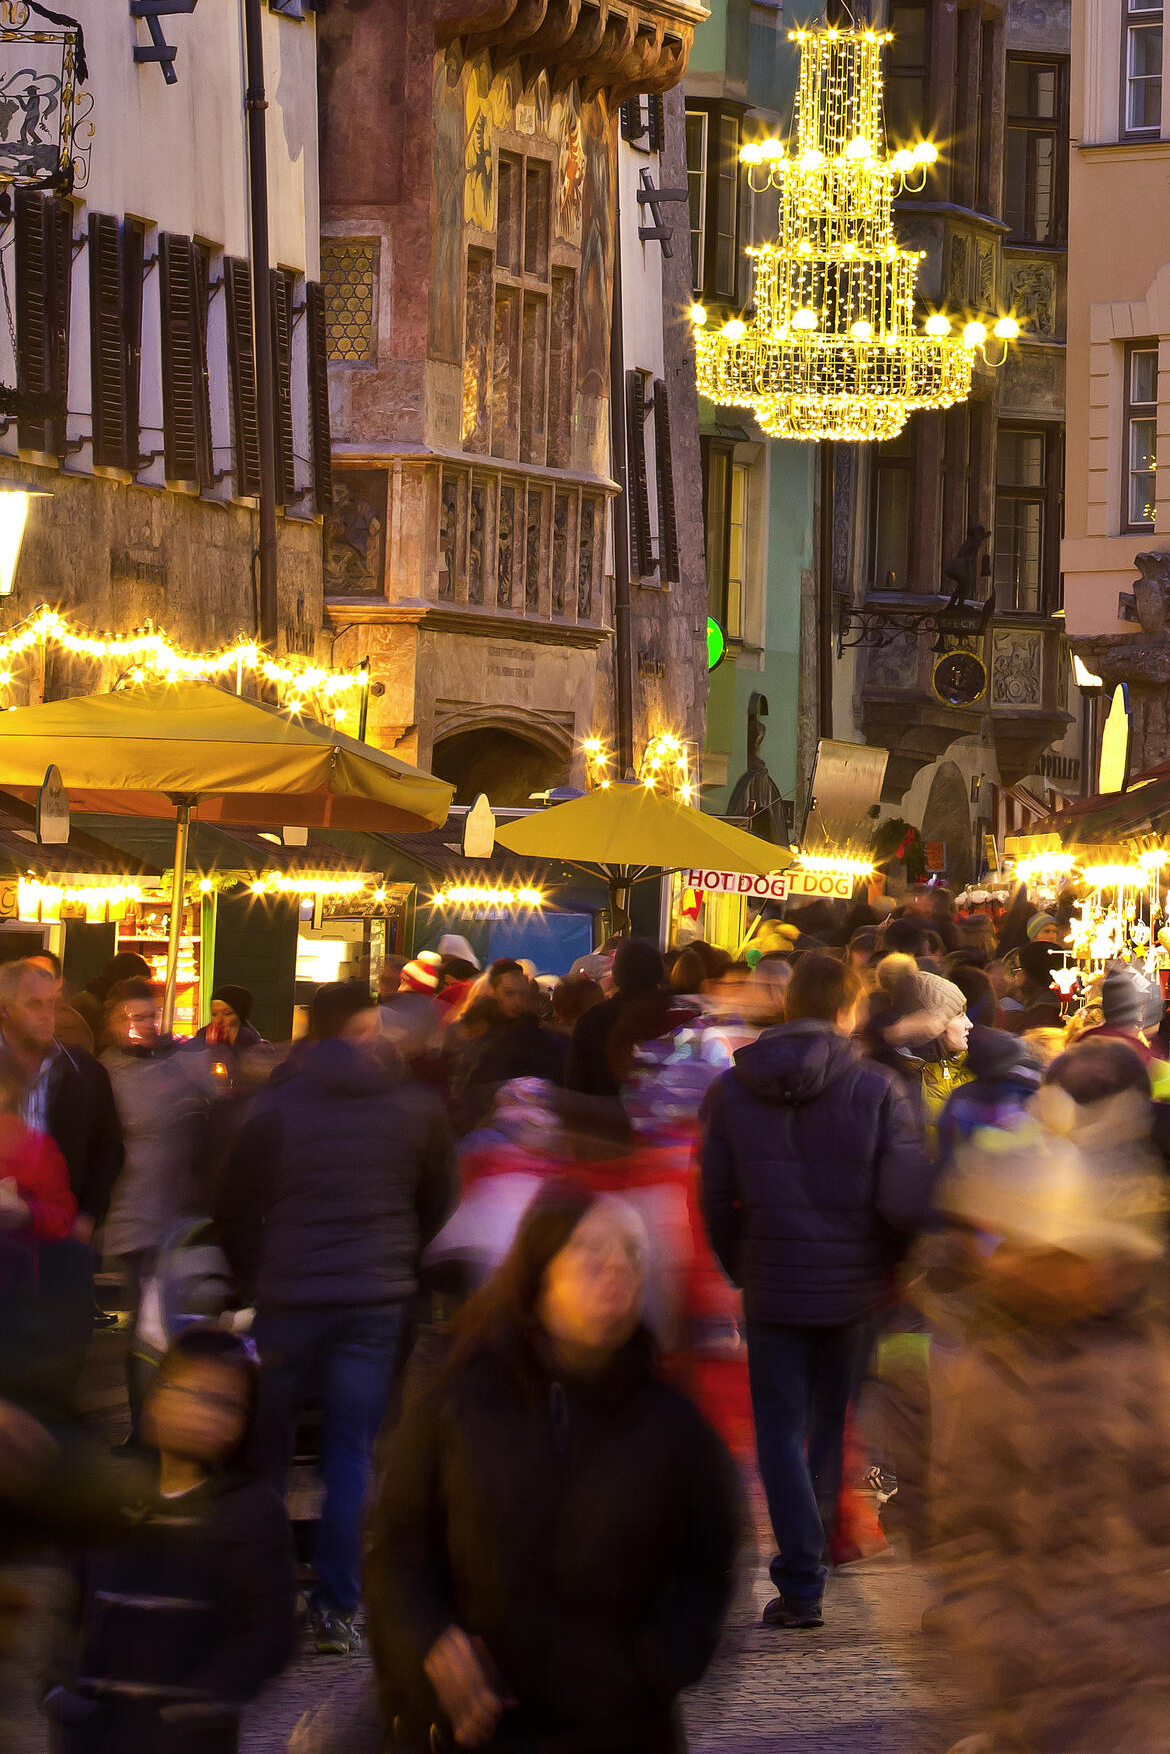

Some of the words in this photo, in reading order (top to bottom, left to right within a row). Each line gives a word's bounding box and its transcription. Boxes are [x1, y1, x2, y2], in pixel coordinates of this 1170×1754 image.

[688, 869, 734, 891] HOT
[738, 874, 786, 897] DOG
[803, 875, 849, 895] DOG
